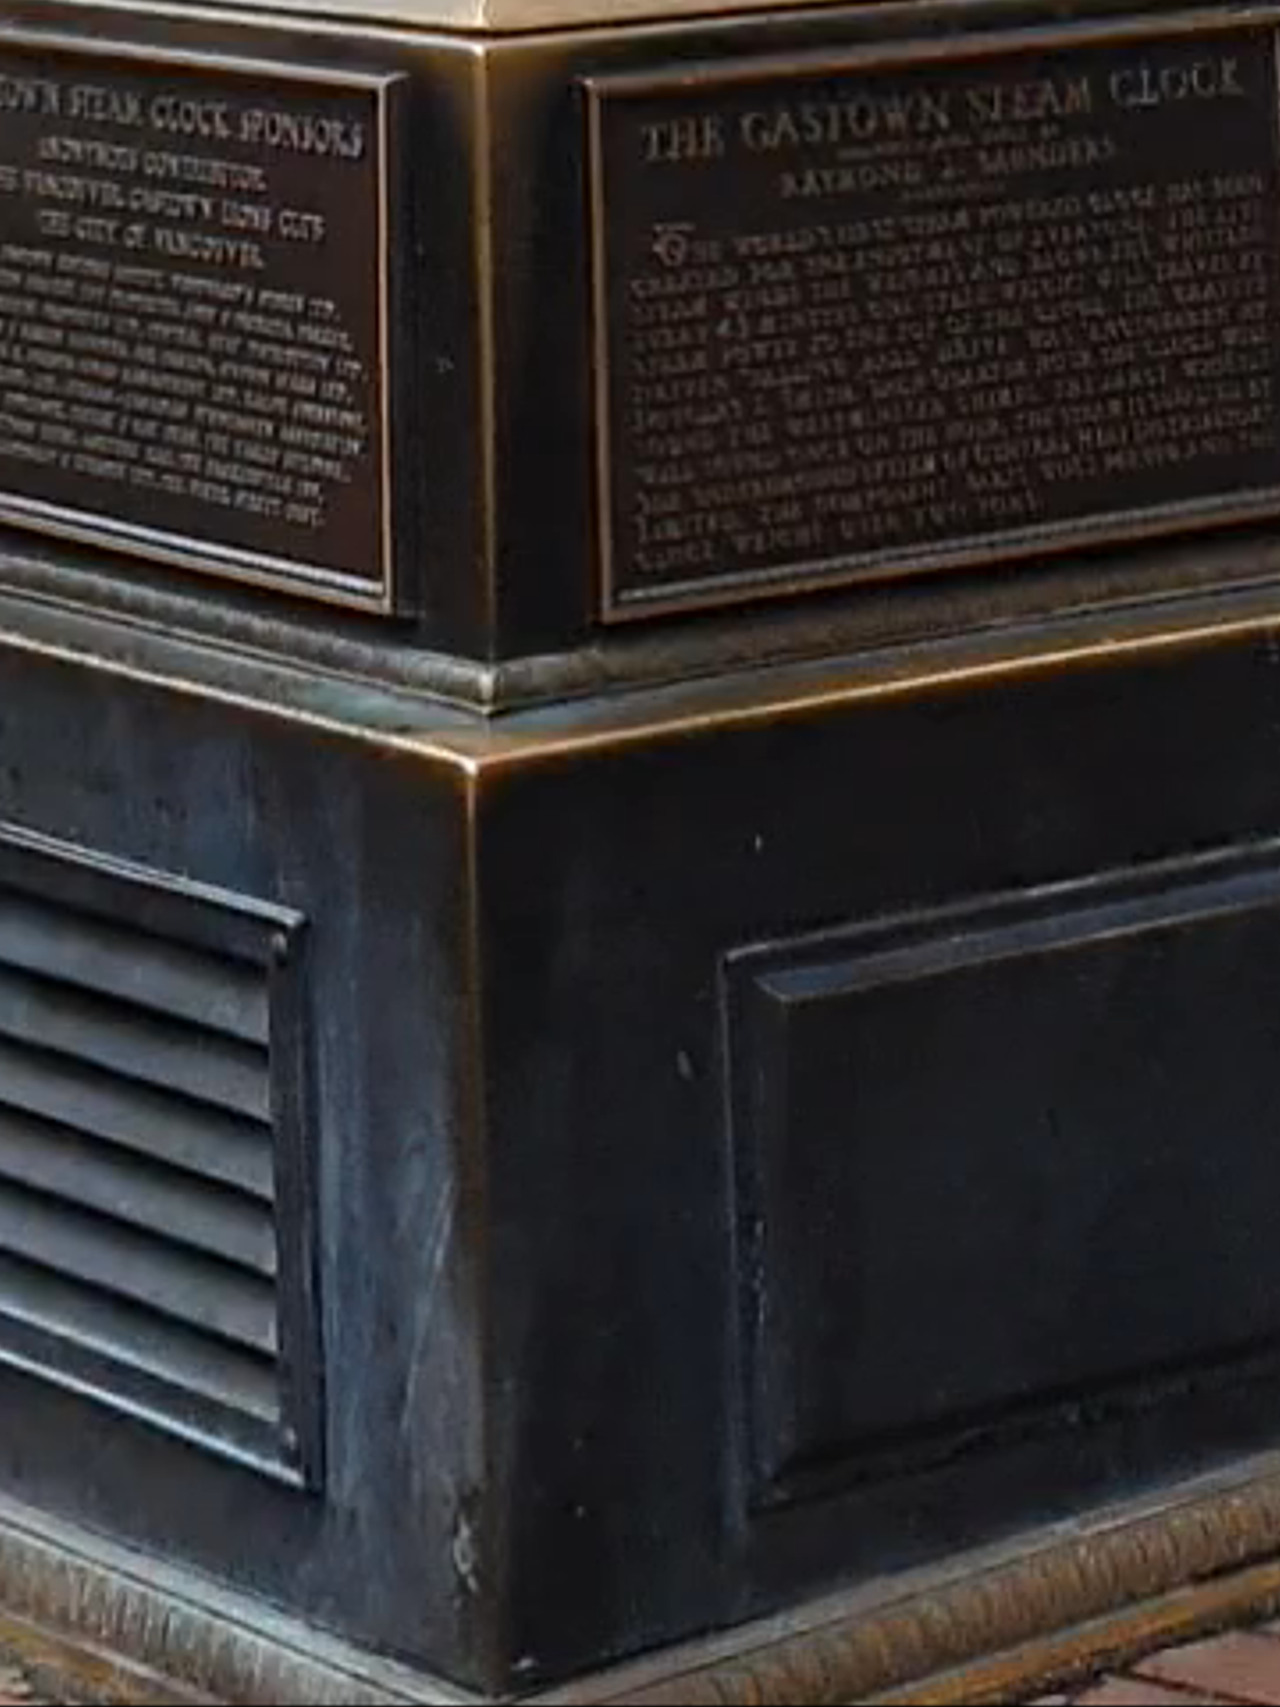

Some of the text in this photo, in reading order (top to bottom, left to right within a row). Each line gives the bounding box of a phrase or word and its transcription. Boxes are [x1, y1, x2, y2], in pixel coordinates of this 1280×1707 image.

[150, 92, 231, 141] CLOCK
[640, 112, 725, 165] THE
[739, 86, 950, 153] GASTOWN
[965, 73, 1092, 126] STEAM
[1109, 54, 1244, 110] CLOCK
